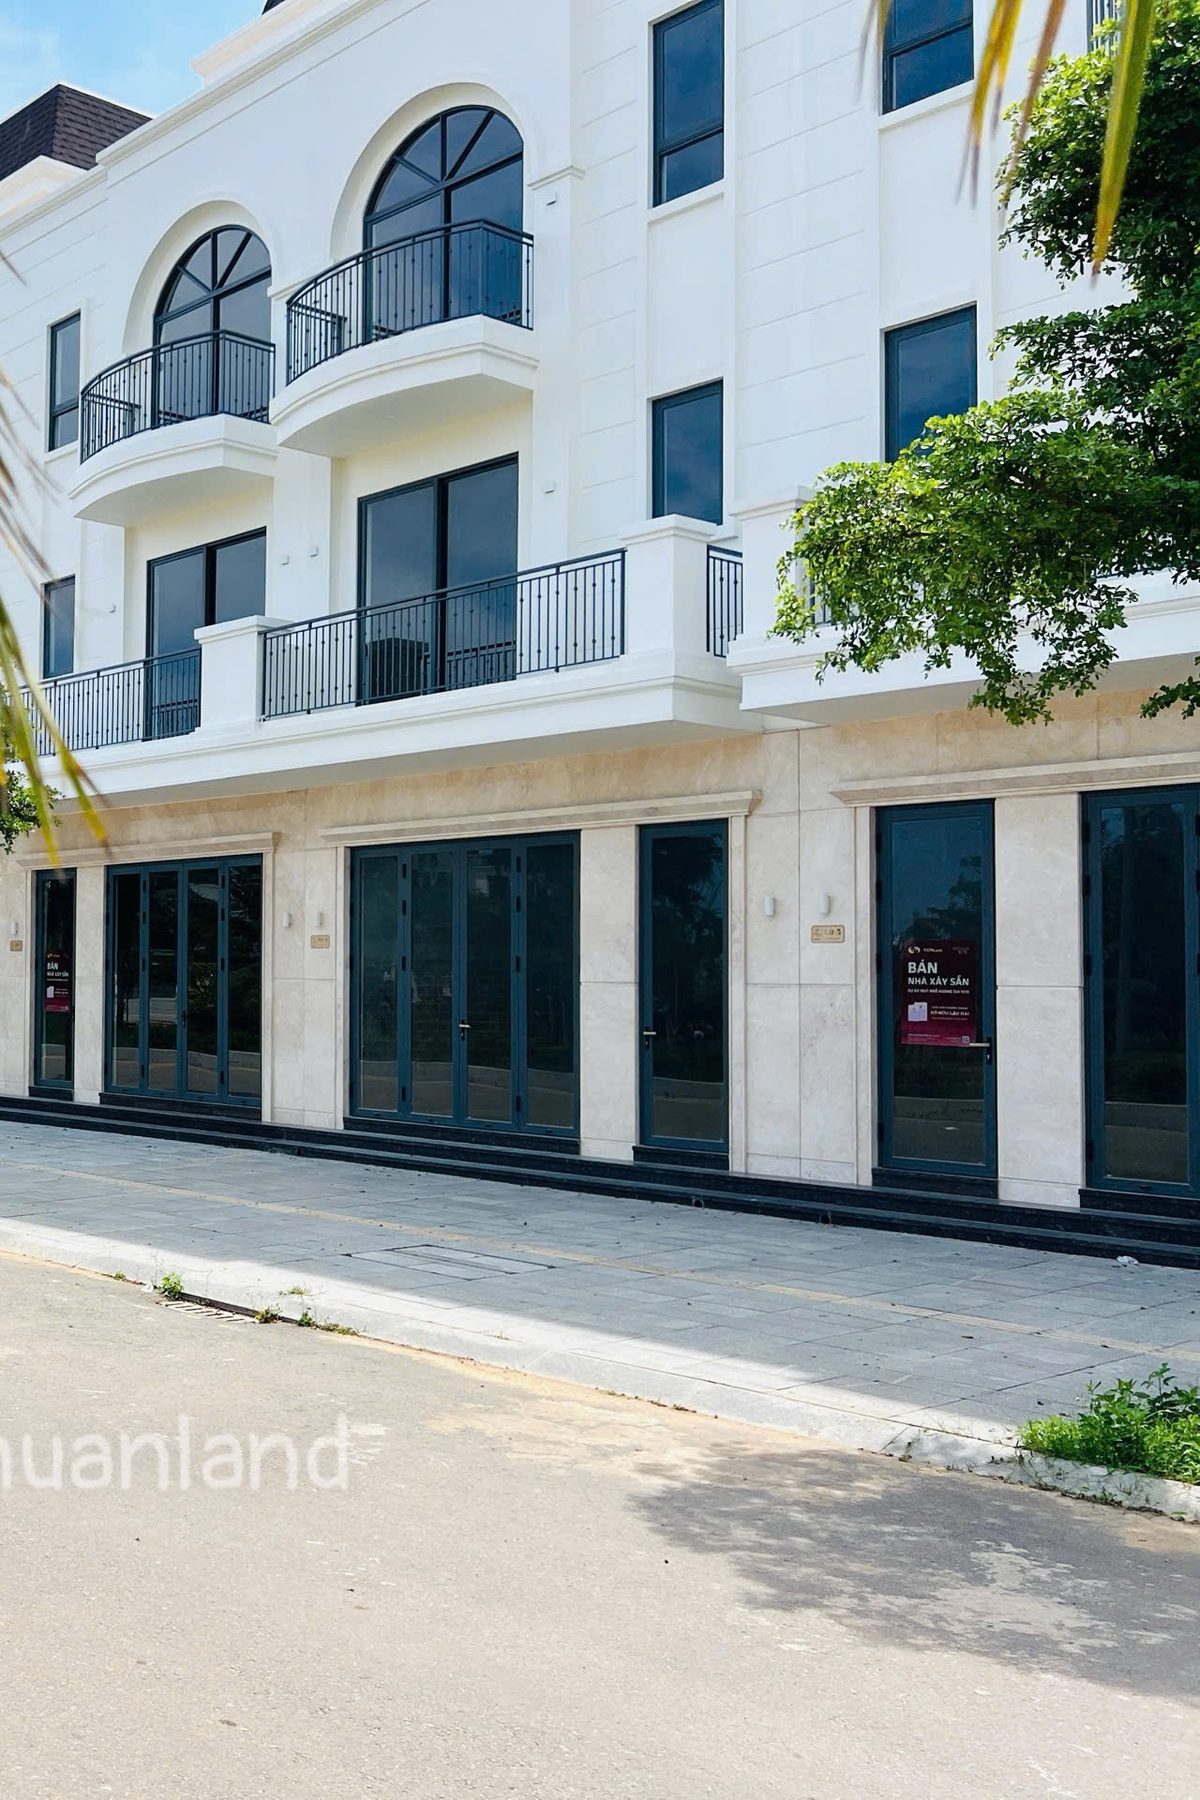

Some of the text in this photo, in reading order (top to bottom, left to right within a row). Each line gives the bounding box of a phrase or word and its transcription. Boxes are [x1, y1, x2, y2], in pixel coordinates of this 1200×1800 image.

[908, 959, 938, 974] BÁN
[908, 975, 928, 985] NHÀ
[930, 975, 948, 986] XÂY
